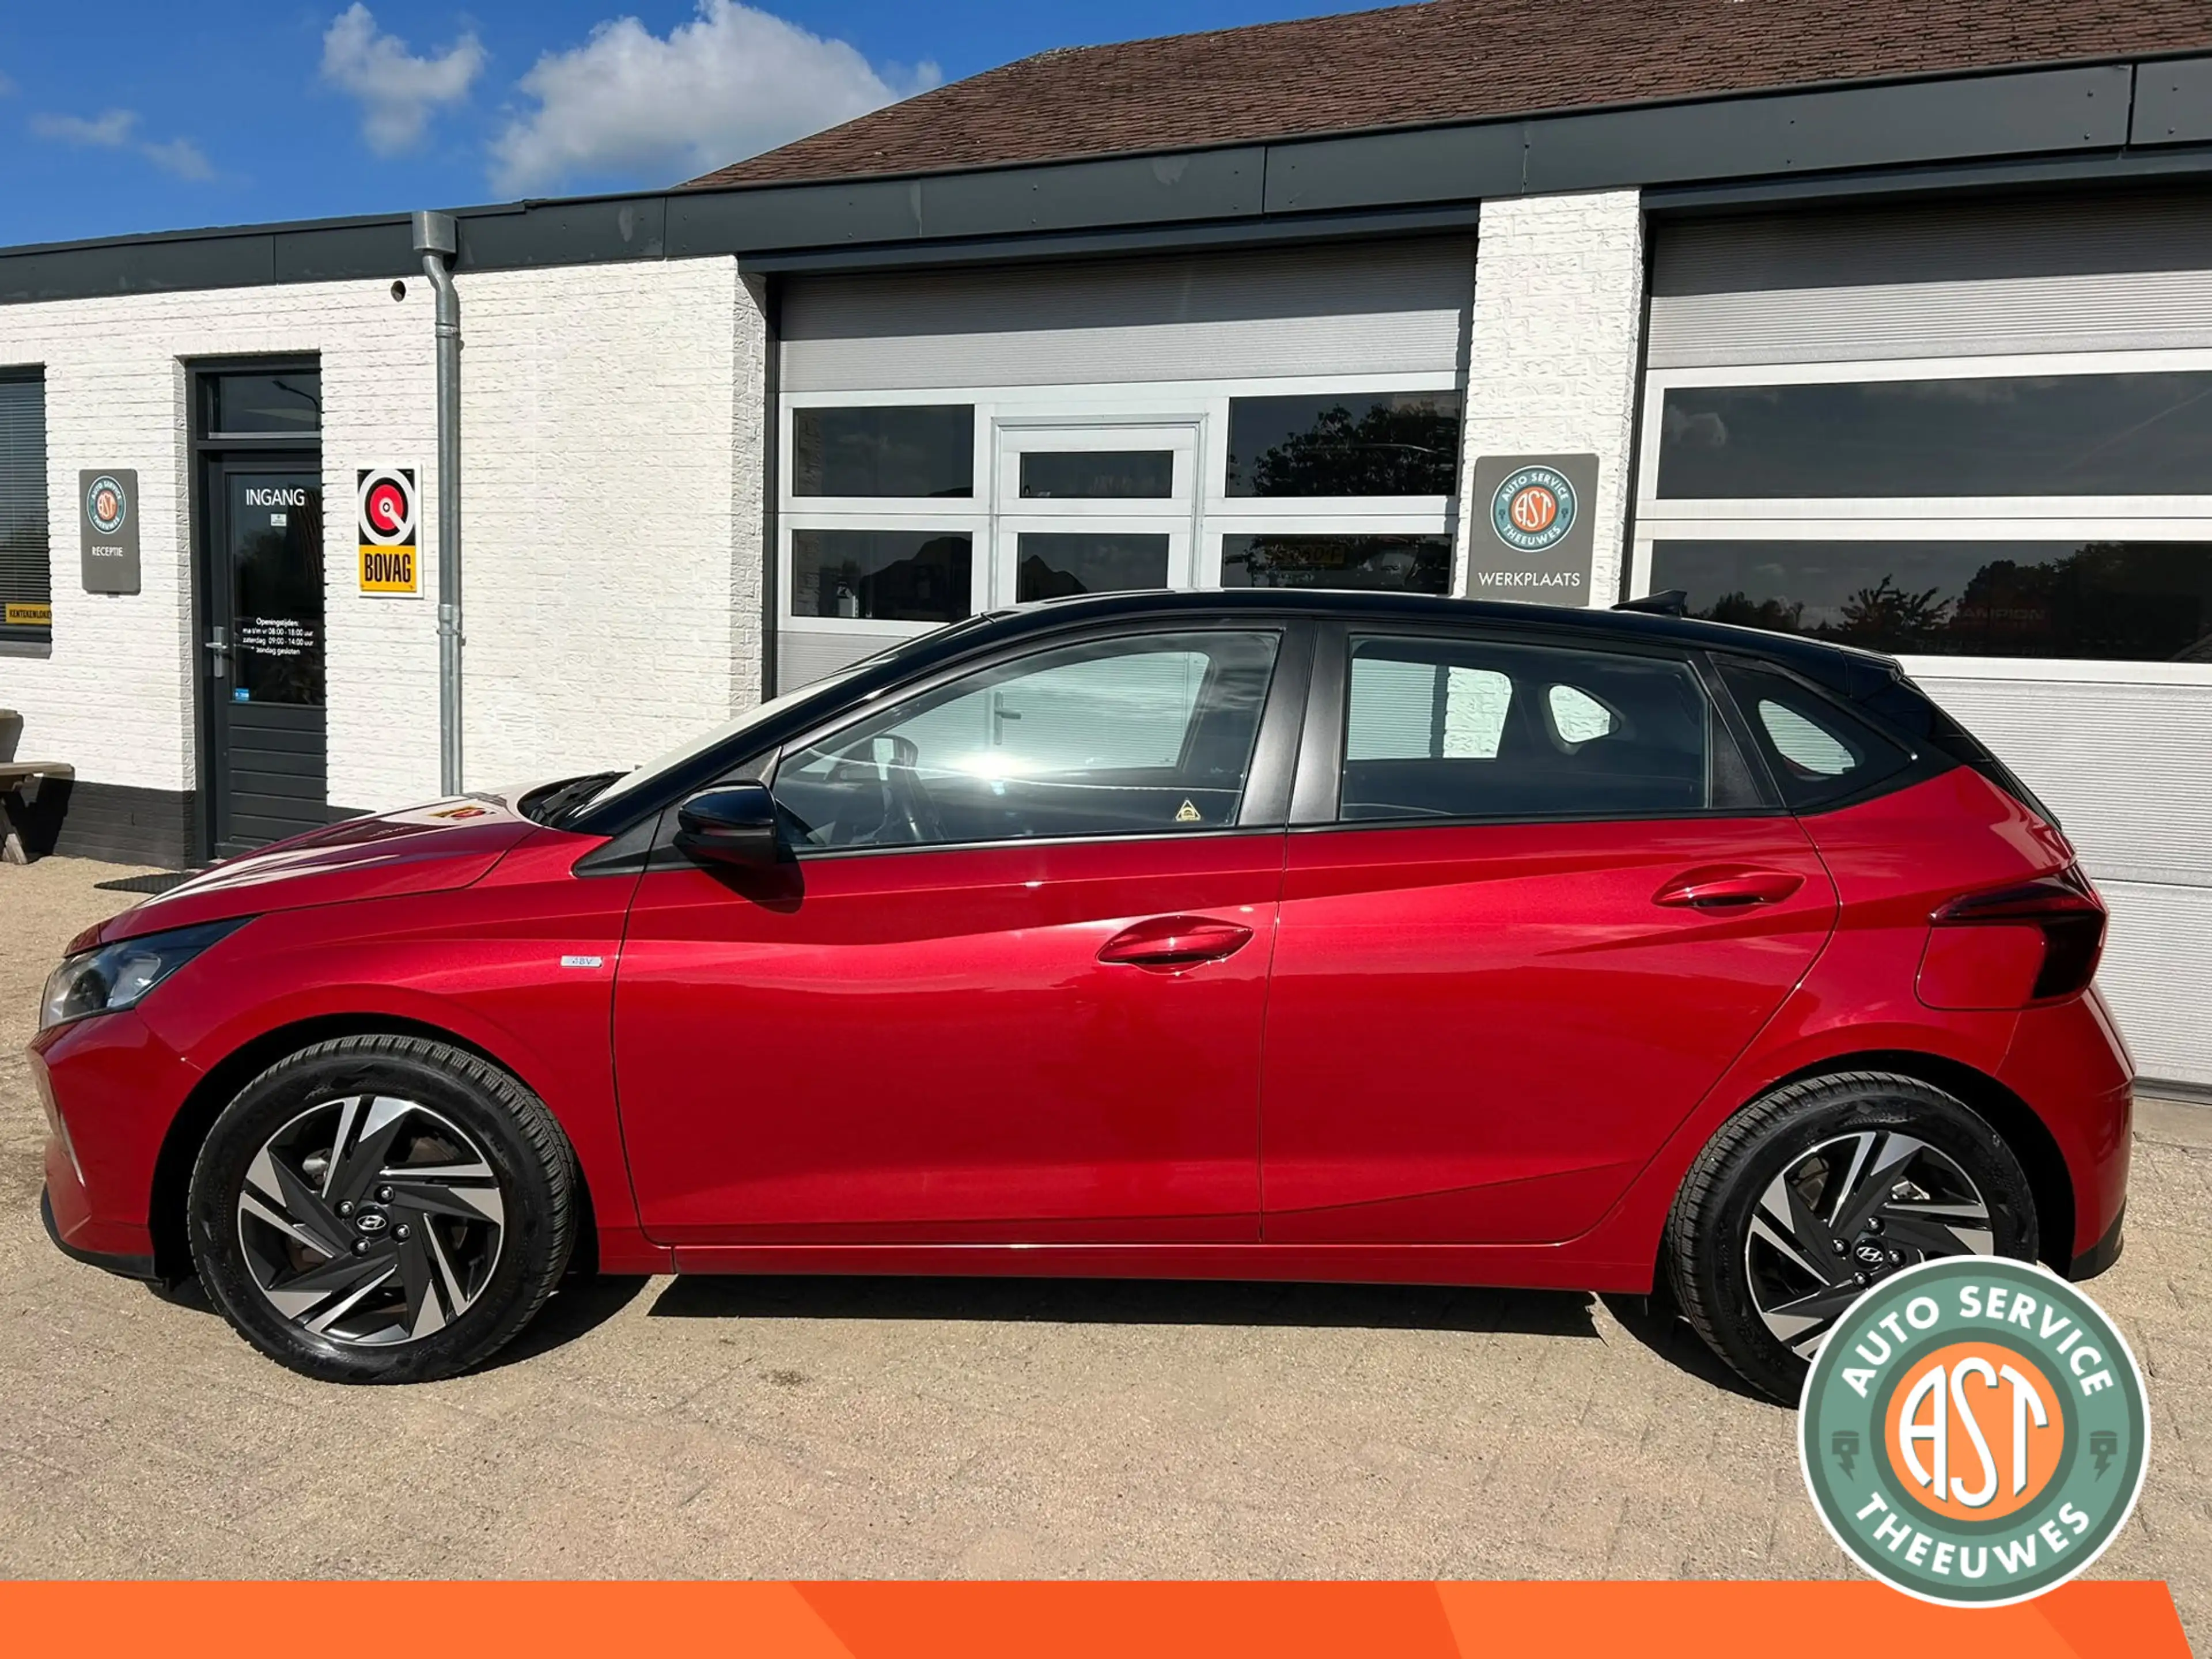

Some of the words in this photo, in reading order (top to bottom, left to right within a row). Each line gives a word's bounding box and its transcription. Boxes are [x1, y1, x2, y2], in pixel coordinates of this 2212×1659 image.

[246, 488, 305, 506] INGANG
[1501, 475, 1528, 502] AUTO
[1531, 472, 1569, 501] SERVICE
[1515, 490, 1552, 528] AST
[1503, 524, 1562, 546] THEEUWES
[92, 546, 124, 557] RECEPTIE
[364, 552, 411, 583] BOVAG
[1478, 571, 1581, 587] WERKPLAATS
[243, 637, 266, 646] zaterdag
[268, 637, 285, 645] 09:00
[288, 638, 304, 646] 14:00
